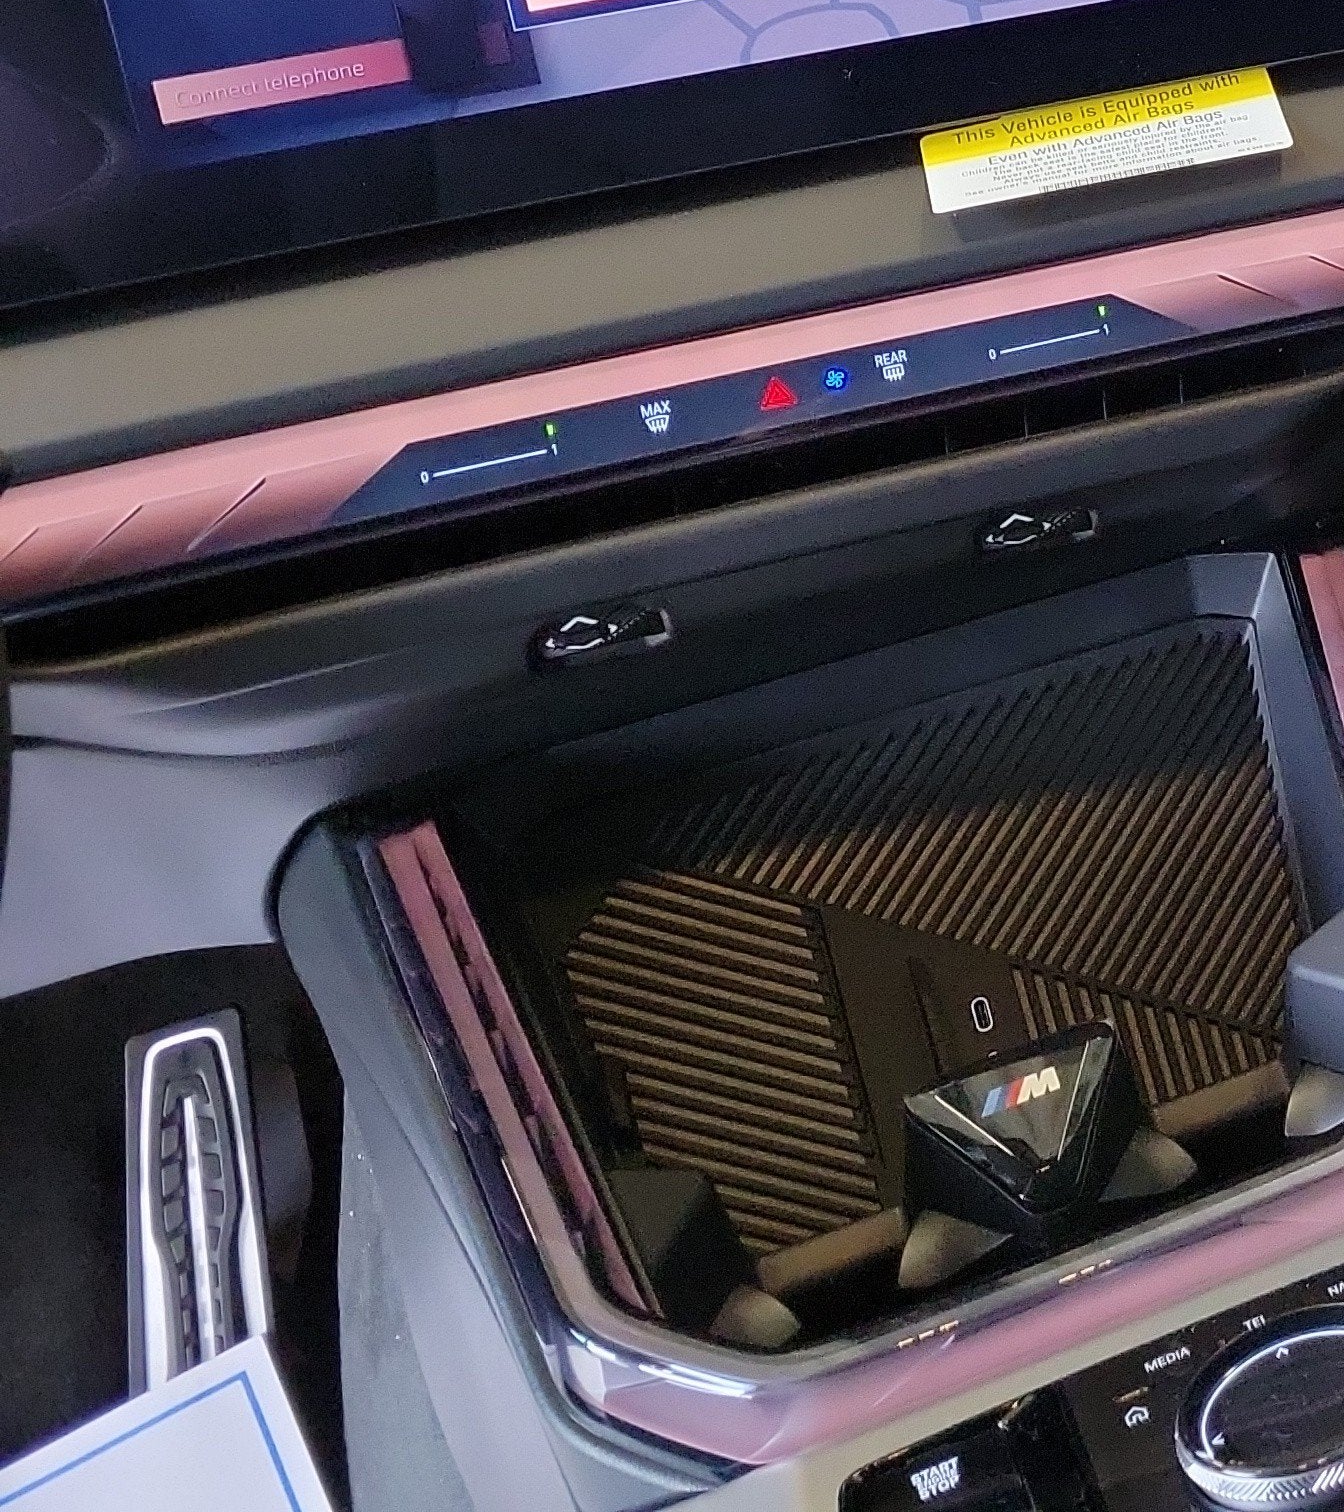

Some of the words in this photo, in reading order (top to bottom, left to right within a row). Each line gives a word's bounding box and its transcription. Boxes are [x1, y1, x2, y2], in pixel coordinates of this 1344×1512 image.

[174, 82, 259, 110] Connect
[264, 61, 366, 93] telephone
[954, 125, 995, 145] This
[1001, 108, 1074, 135] Vehicle
[1079, 103, 1096, 118] is
[1102, 83, 1194, 116] Equipped
[1199, 73, 1240, 91] with
[1007, 117, 1106, 147] Advanced
[1111, 110, 1140, 126] Air
[1146, 99, 1195, 119] Bags
[988, 149, 1028, 165] Even
[1032, 141, 1067, 156] with
[1071, 124, 1151, 148] Advanced
[1155, 119, 1179, 131] Air
[1183, 110, 1223, 126] Bags
[874, 349, 908, 368] REAR
[989, 348, 997, 360] 0
[1103, 324, 1109, 336] 1
[640, 400, 672, 420] MAX
[420, 470, 429, 483] 0
[551, 443, 558, 457] 1
[1143, 1346, 1191, 1374] MEDIA
[910, 1456, 959, 1488] START
[919, 1473, 960, 1502] STOP
